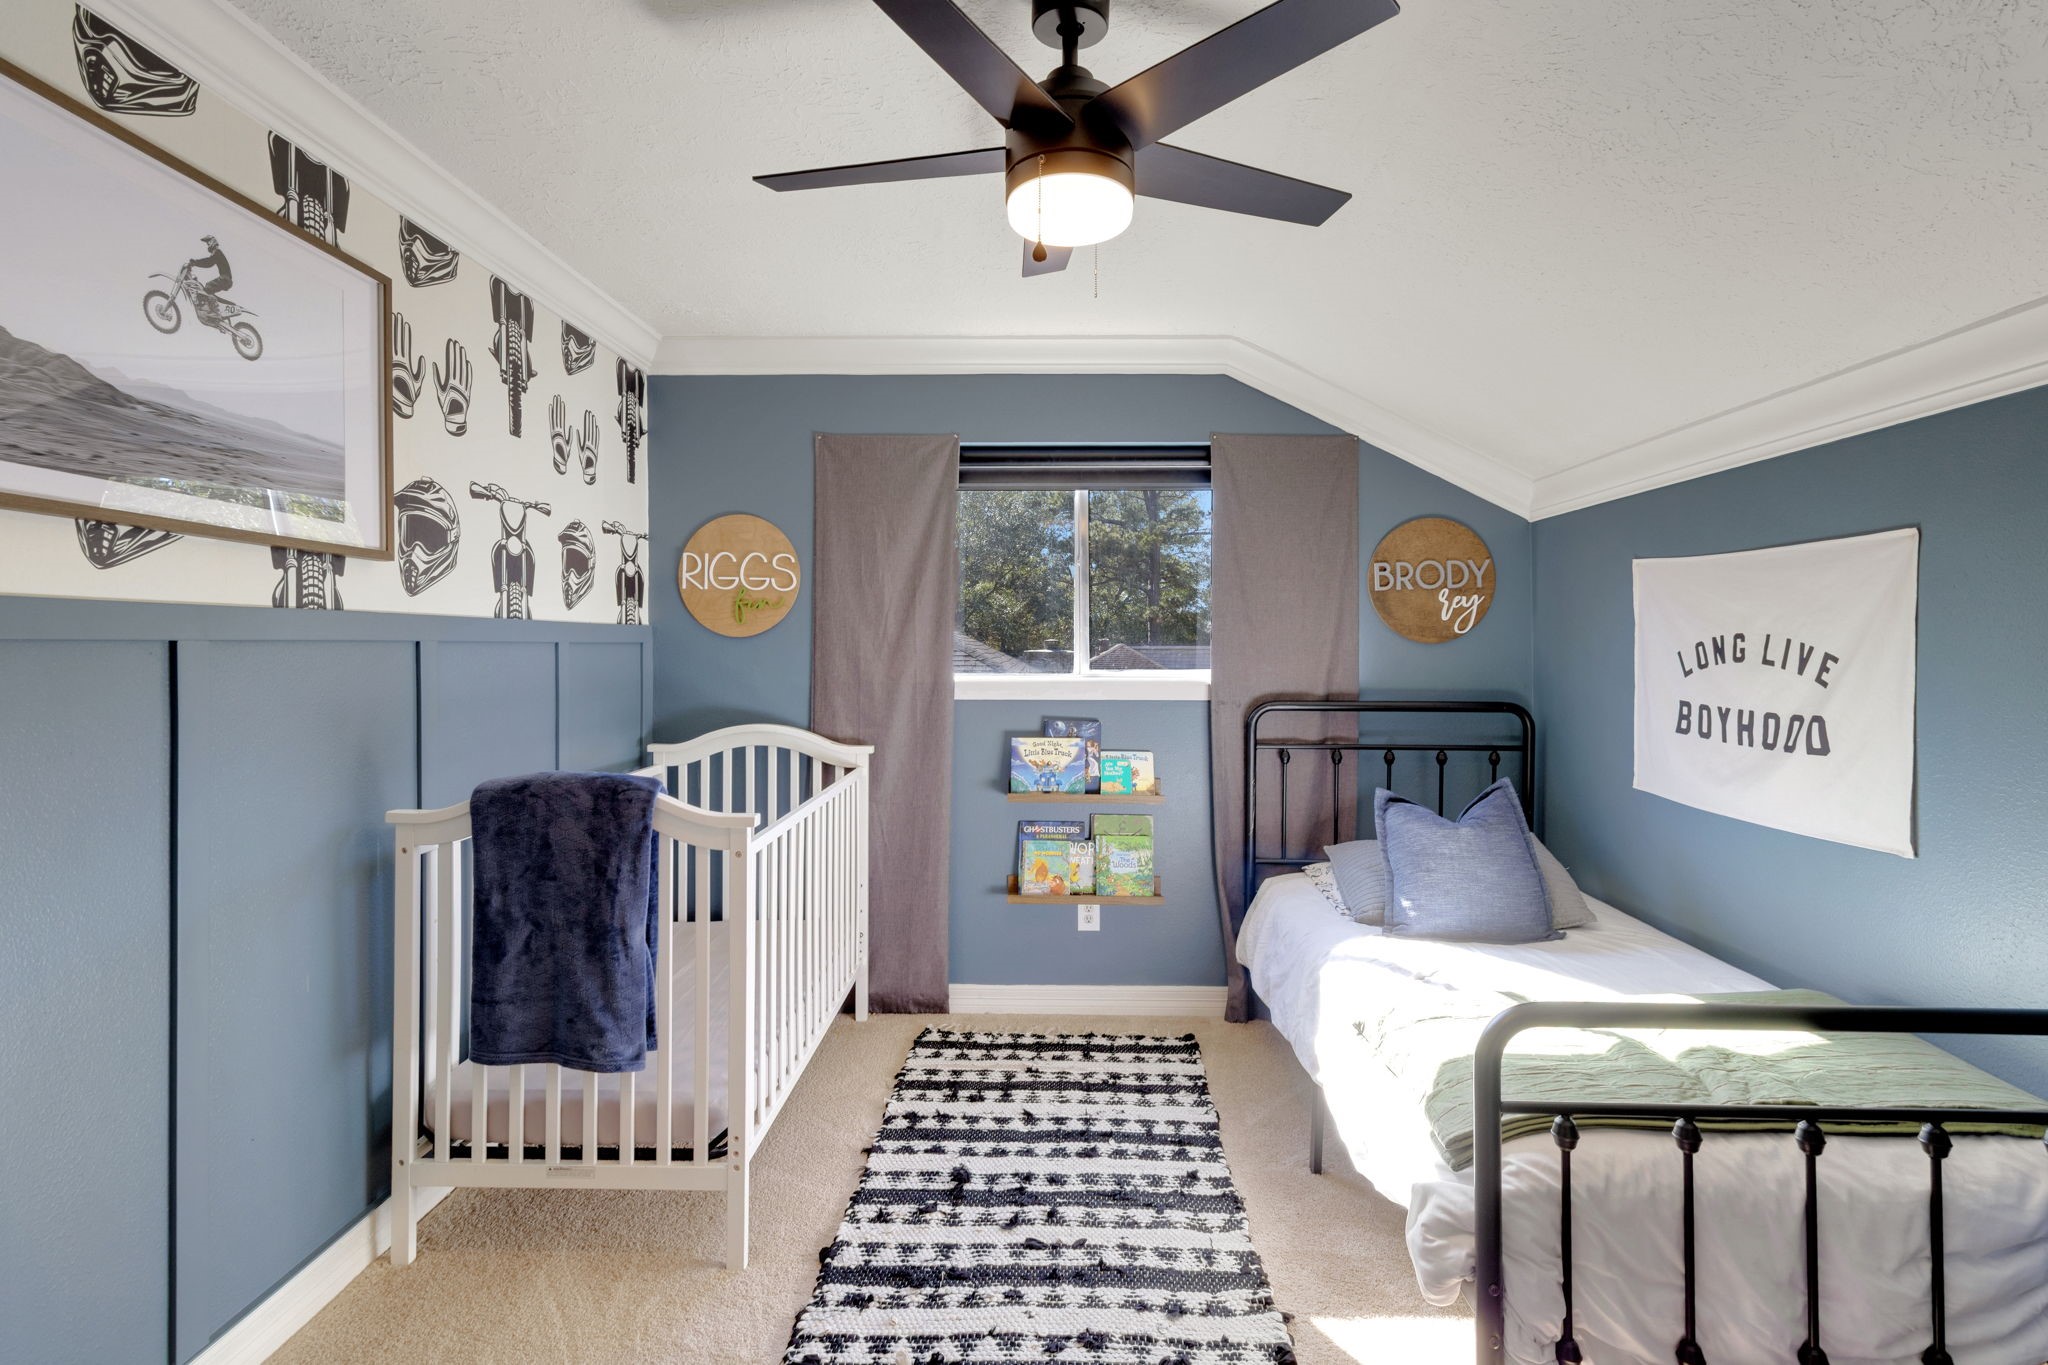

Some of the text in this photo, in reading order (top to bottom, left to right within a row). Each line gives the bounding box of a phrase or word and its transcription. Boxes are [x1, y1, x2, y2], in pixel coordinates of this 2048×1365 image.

[682, 551, 798, 592] RIGGS
[1373, 559, 1491, 592] BRODY
[1677, 633, 1840, 689] LONG LIVE
[1675, 699, 1831, 756] BOYHOOD
[1024, 748, 1072, 757] Little Blue Truck
[1024, 825, 1080, 834] GHOSTBUSTERS
[1112, 860, 1137, 869] Woods
